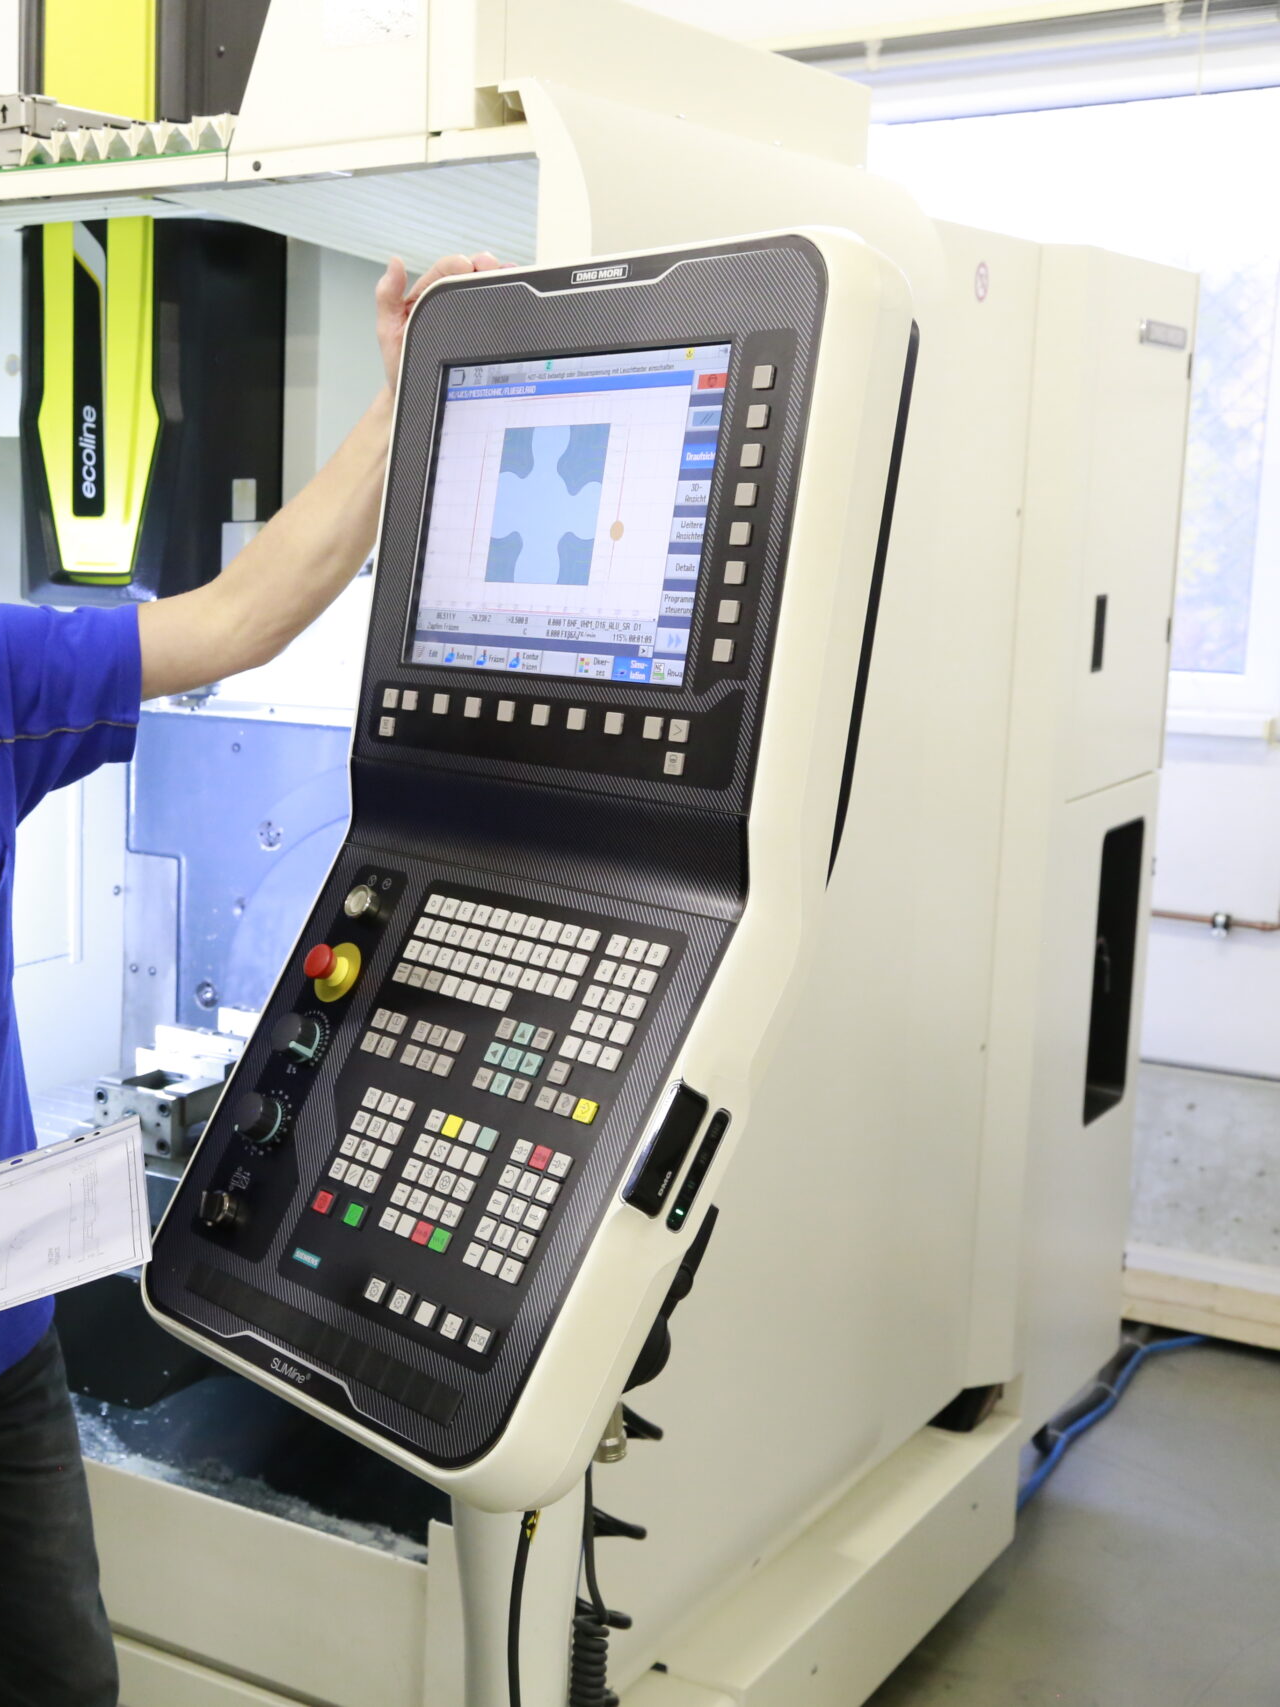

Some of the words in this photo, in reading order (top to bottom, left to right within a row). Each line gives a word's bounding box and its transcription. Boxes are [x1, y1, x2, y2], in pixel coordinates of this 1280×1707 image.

[576, 271, 598, 282] DMG
[598, 267, 623, 279] MORI
[78, 405, 97, 499] ecoline
[657, 1170, 672, 1197] DMG
